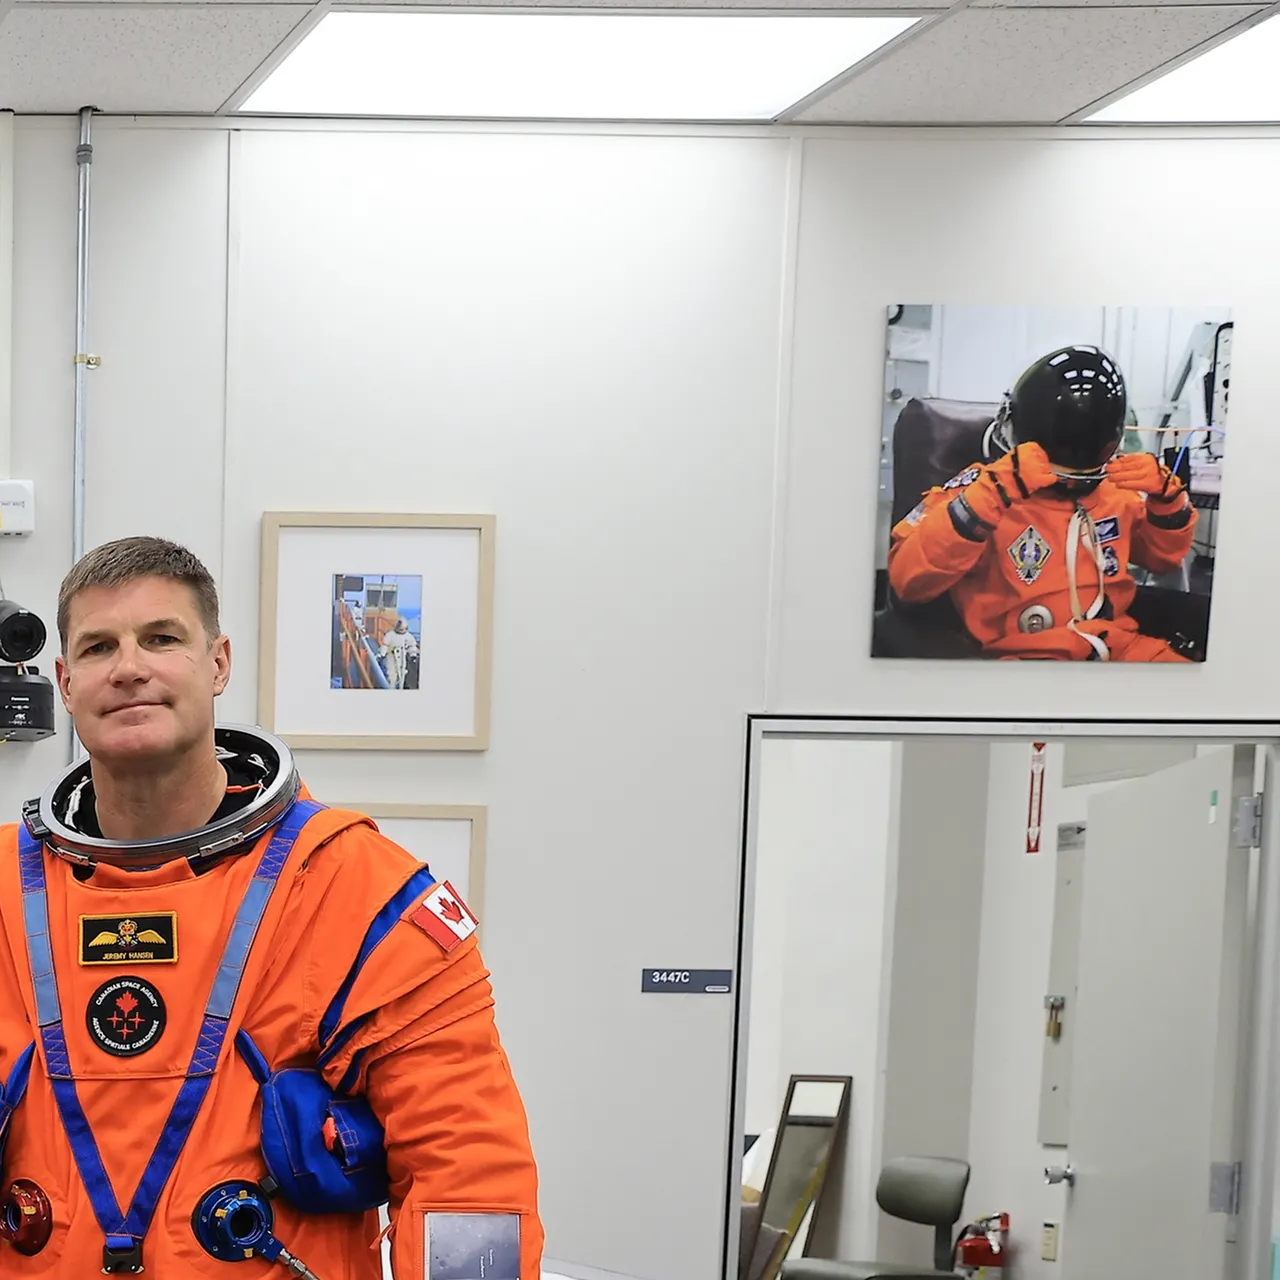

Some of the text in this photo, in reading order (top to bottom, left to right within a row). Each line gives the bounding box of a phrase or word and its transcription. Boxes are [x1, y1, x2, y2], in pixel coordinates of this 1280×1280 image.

[102, 952, 128, 960] JEREMY
[652, 971, 690, 983] 3447C
[95, 981, 159, 1008] CANADIAN SPACE AGENCY
[92, 1017, 160, 1050] AGENCE SPATIALE CANADIENNE
